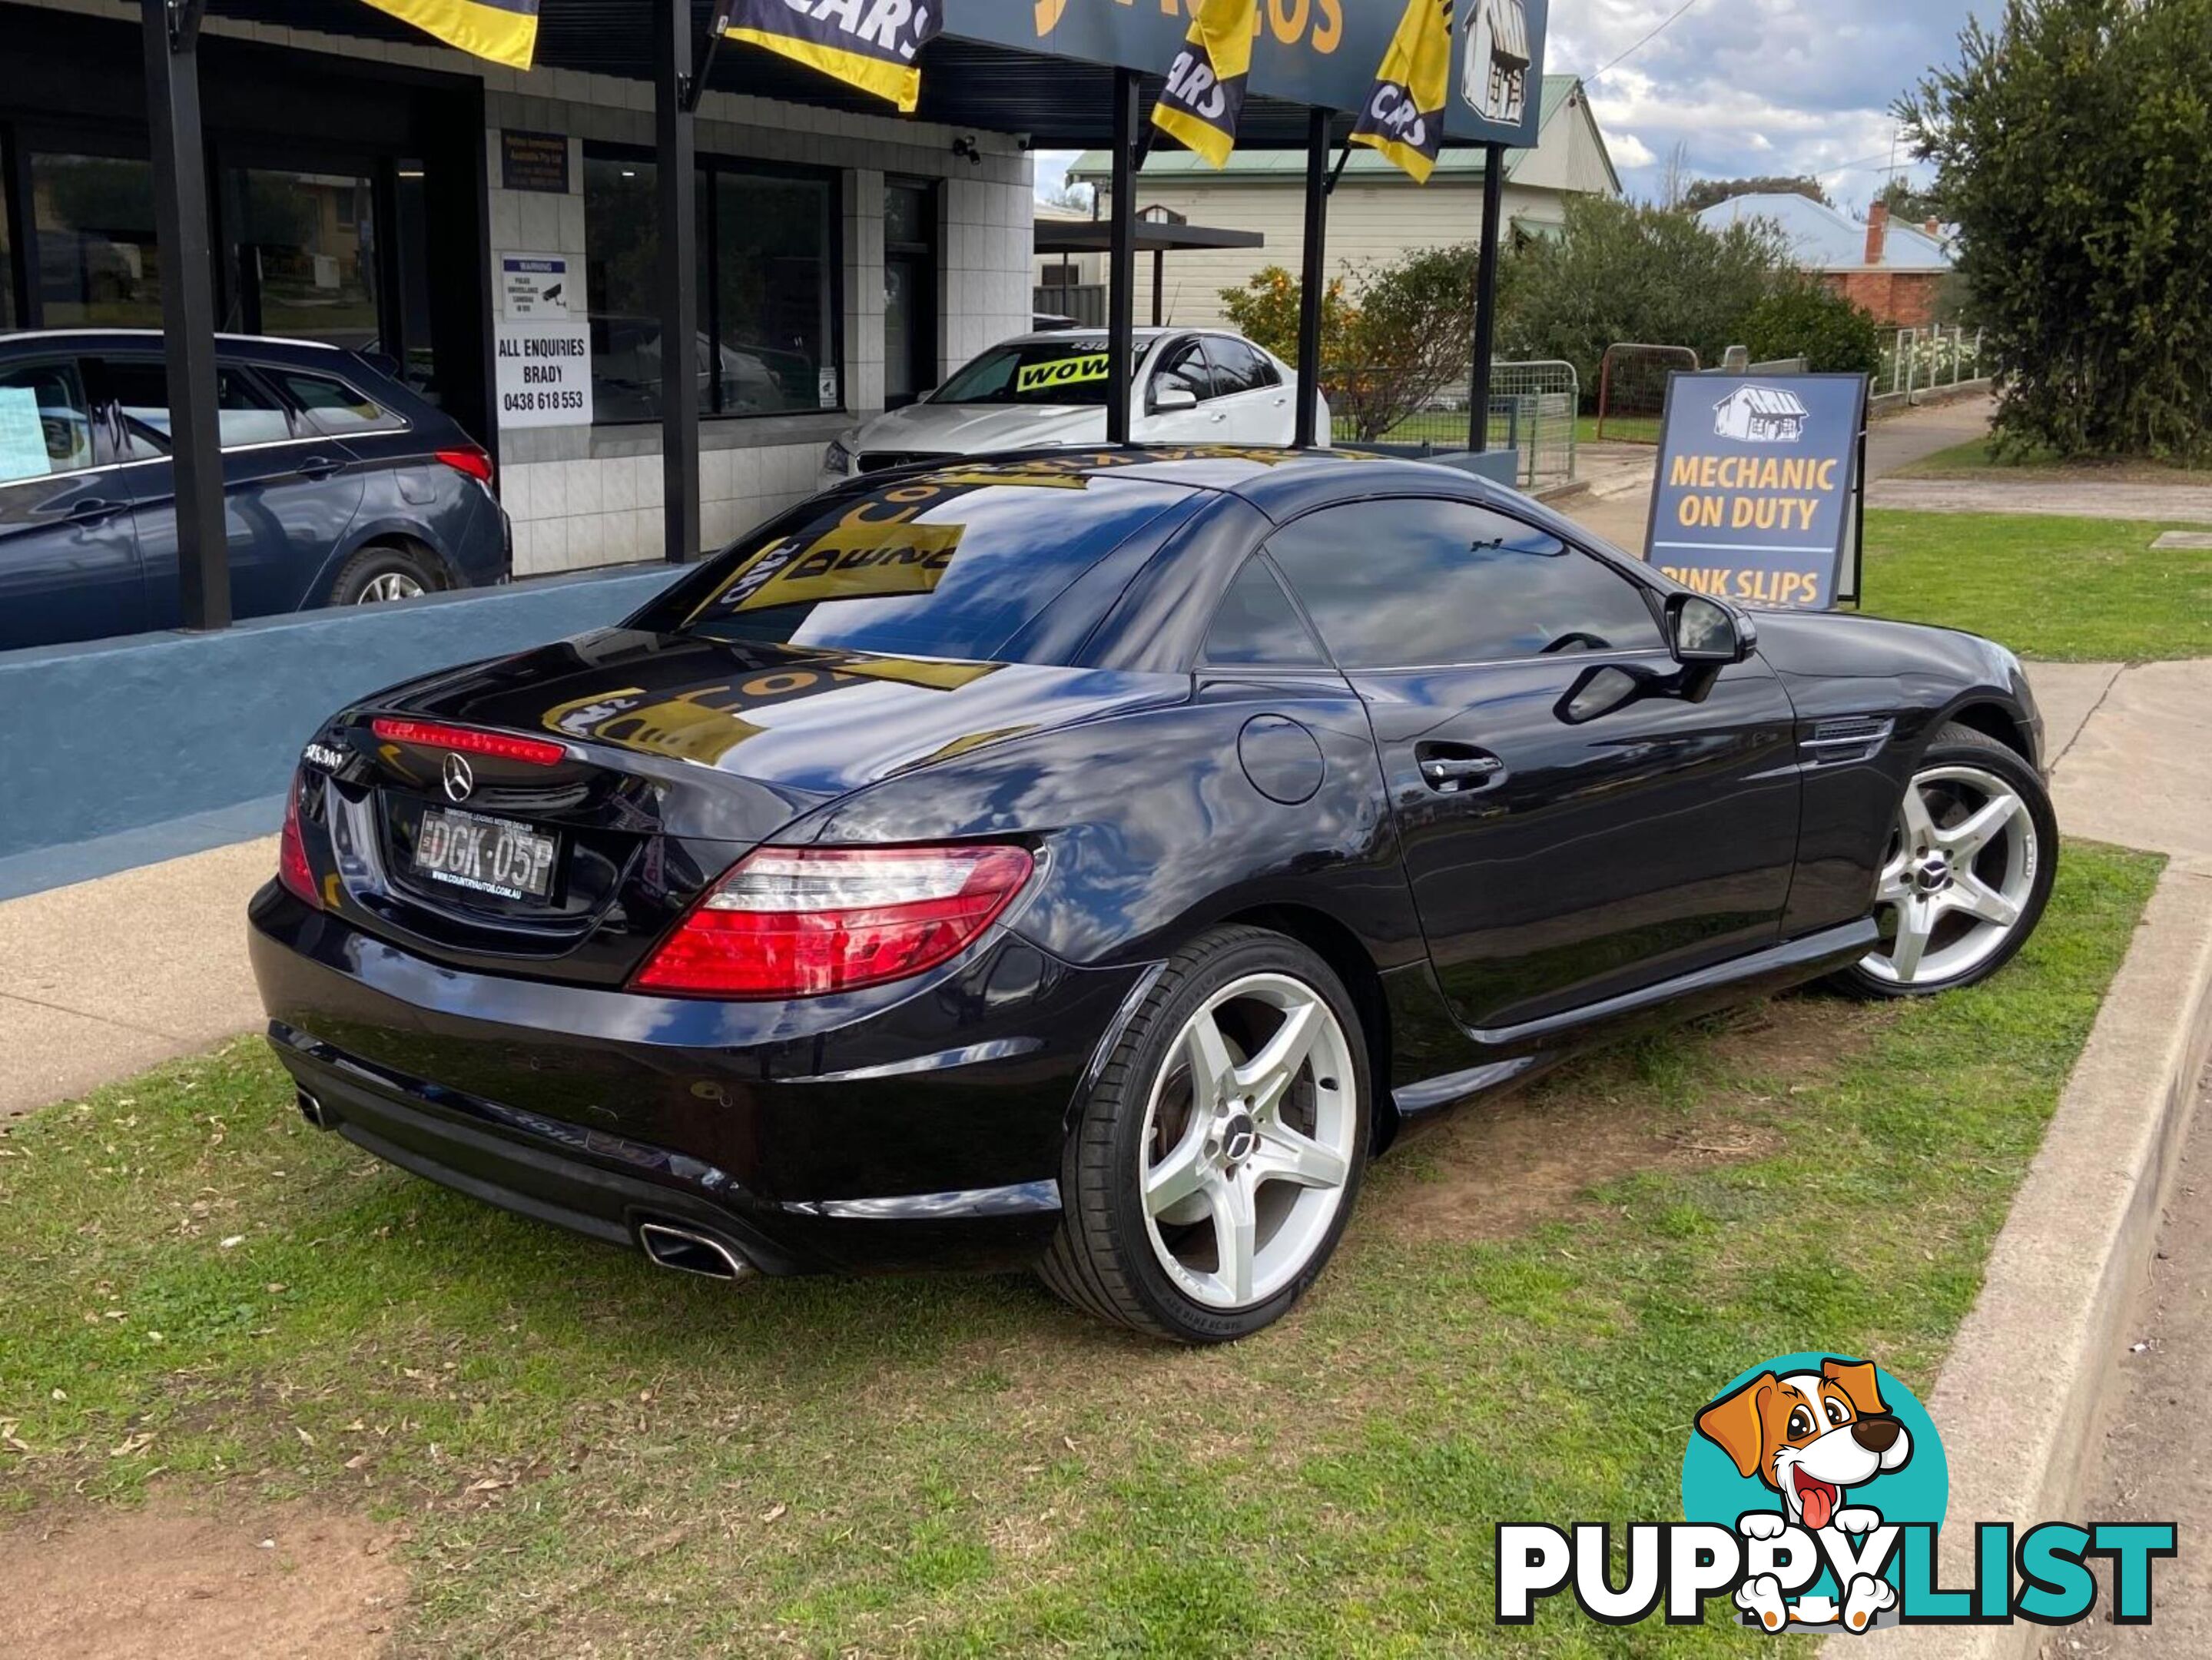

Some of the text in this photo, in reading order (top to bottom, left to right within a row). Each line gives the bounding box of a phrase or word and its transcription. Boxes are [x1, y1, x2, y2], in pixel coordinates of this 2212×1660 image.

[784, 0, 928, 60] ARS
[1166, 51, 1225, 118] ARS
[499, 338, 585, 358] ALL ENQUIRIES
[524, 365, 562, 383] BRADY
[1023, 359, 1109, 386] WOW
[504, 390, 583, 411] 0438 618 553
[1670, 456, 1838, 491] MECHANIC
[1679, 495, 1819, 530] ON DUTY
[1736, 569, 1818, 603] SLIPS
